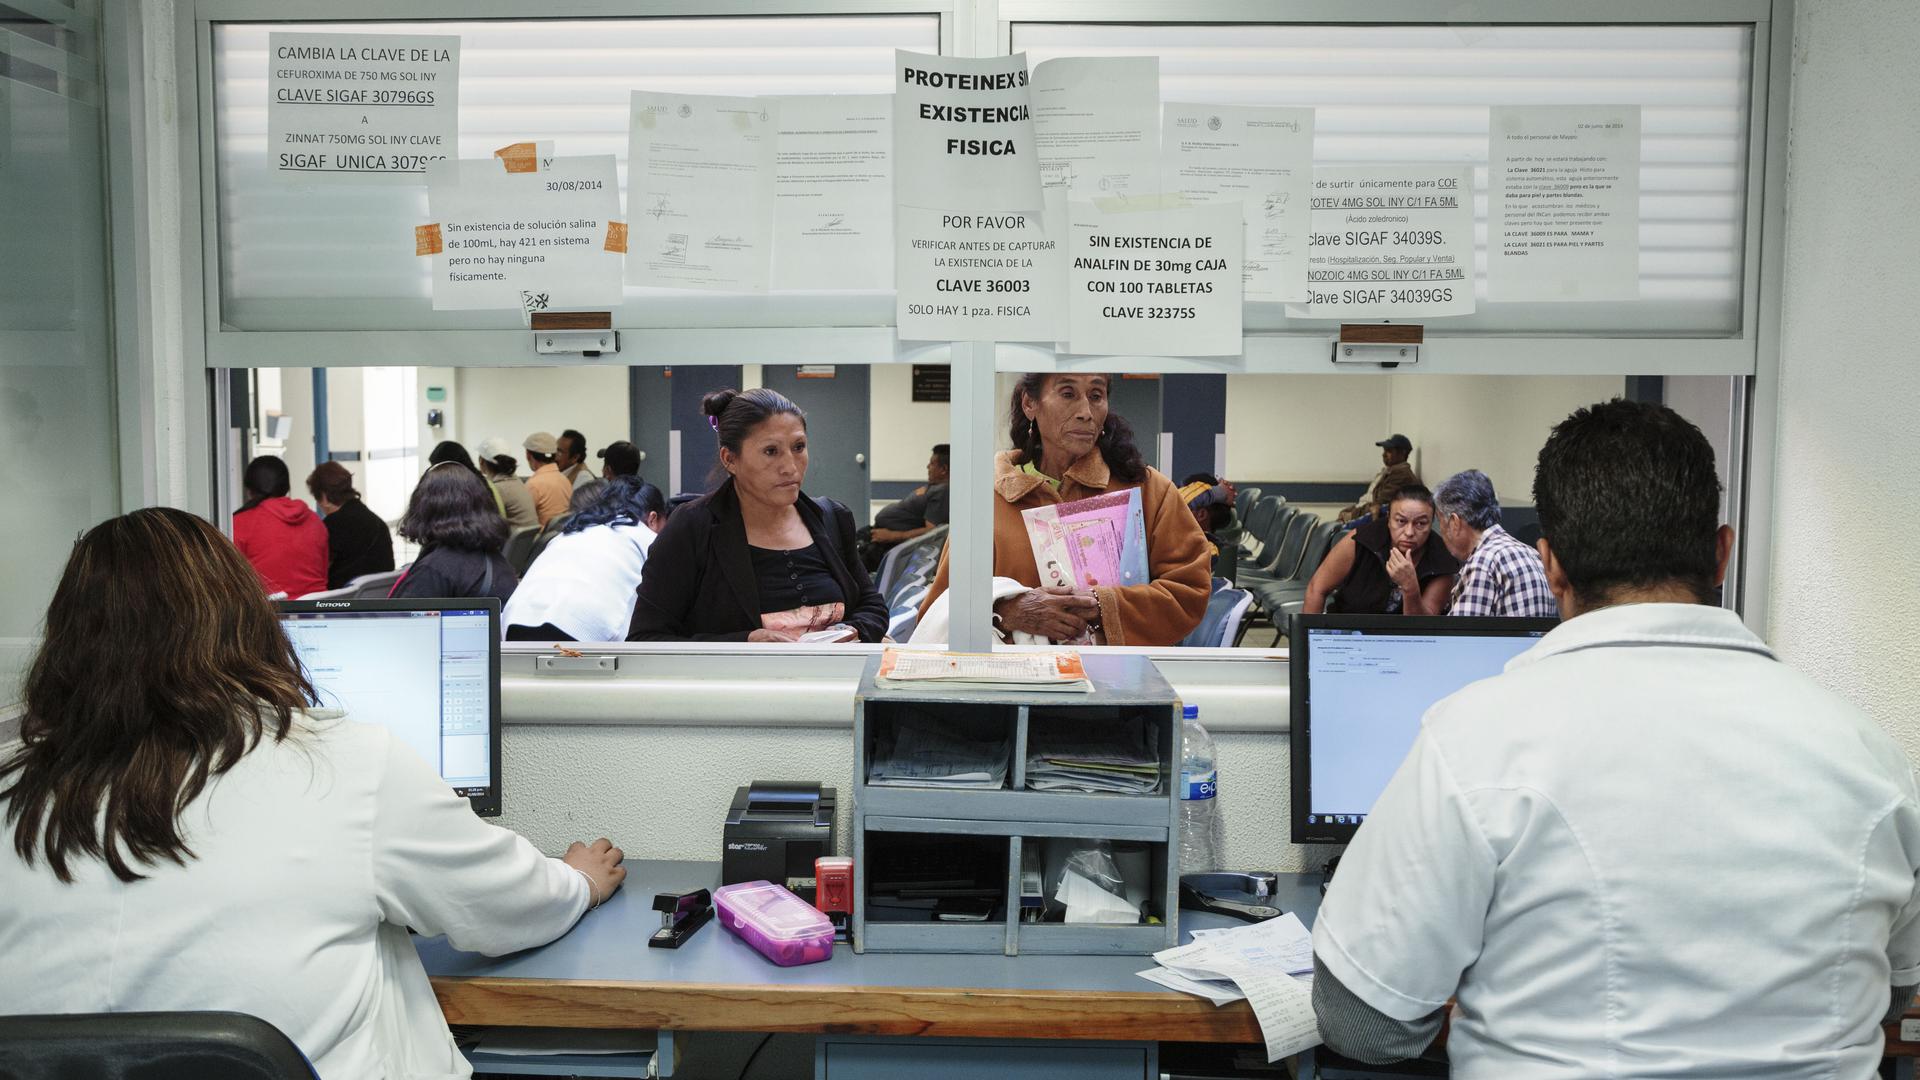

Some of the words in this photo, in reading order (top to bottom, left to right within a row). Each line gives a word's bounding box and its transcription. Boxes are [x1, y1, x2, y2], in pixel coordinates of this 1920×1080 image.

[278, 47, 335, 60] CAMBIA
[340, 48, 356, 60] LA
[362, 48, 406, 61] CLAVE
[411, 49, 429, 62] DE
[434, 50, 450, 62] LA
[277, 70, 342, 80] CEFUROXIMA
[345, 71, 357, 80] DE
[360, 72, 378, 80] 750
[380, 72, 397, 80] MG
[400, 72, 417, 80] SOL
[420, 72, 436, 80] INY
[904, 67, 1016, 90] PROTEINEX
[278, 88, 322, 102] CLAVE
[326, 90, 368, 102] SIGAF
[372, 90, 434, 103] 30796GS
[920, 103, 1030, 122] EXISTENCIA
[361, 116, 368, 124] A
[286, 133, 325, 144] ZINNAT
[328, 134, 366, 144] 750MG
[368, 135, 388, 144] SOL
[390, 136, 407, 144] INY
[410, 136, 442, 144] CLAVE
[947, 138, 1016, 156] FISICA
[280, 154, 327, 168] SIGAF
[336, 154, 386, 169] UNICA
[391, 156, 446, 169] 3079
[546, 180, 602, 192] 30/08/2014
[1316, 180, 1328, 188] de
[1330, 180, 1354, 188] surtir
[1360, 179, 1412, 188] únicamente
[1416, 180, 1436, 190] para
[1438, 178, 1457, 188] COE
[1311, 198, 1340, 208] OTEV
[1342, 198, 1364, 207] 4MG
[1366, 197, 1385, 207] SOL
[1388, 197, 1404, 206] INY
[1407, 197, 1422, 206] C/1
[1425, 197, 1438, 206] FA
[1440, 196, 1458, 206] 5ML
[448, 223, 462, 232] Sin
[466, 222, 510, 232] existencia
[513, 221, 524, 230] de
[528, 220, 566, 230] solución
[570, 219, 596, 228] salina
[943, 216, 972, 228] POR
[977, 216, 1025, 228] FAVOR
[448, 240, 460, 248] de
[464, 239, 496, 249] 100mL,
[500, 238, 516, 248] hay
[519, 237, 536, 246] 421
[540, 238, 550, 246] en
[554, 236, 590, 246] sistema
[912, 239, 956, 250] VERIFICAR
[959, 242, 990, 250] ANTES
[993, 242, 1006, 250] DE
[1008, 240, 1055, 250] CAPTURAR
[1090, 236, 1110, 248] SIN
[1114, 237, 1190, 248] EXISTENCIA
[1195, 237, 1212, 248] DE
[1346, 232, 1388, 246] SIGAF
[1393, 230, 1446, 245] 34039S.
[448, 257, 471, 266] pero
[488, 255, 504, 265] hay
[508, 254, 545, 264] ninguna
[934, 258, 946, 266] LA
[948, 258, 1003, 268] EXISTENCIA
[1006, 259, 1018, 268] DE
[1022, 259, 1032, 267] LA
[1074, 258, 1129, 271] ANALFIN
[1134, 260, 1151, 270] DE
[1155, 260, 1192, 274] 30mg
[1196, 259, 1227, 270] CAJA
[1348, 270, 1368, 280] 4MG
[1372, 270, 1390, 280] SOL
[1394, 270, 1409, 280] INY
[1412, 270, 1426, 280] C/1
[1430, 270, 1442, 278] FA
[1446, 268, 1464, 278] 5ML
[936, 279, 982, 292] CLAVE
[986, 280, 1030, 292] 36003
[1088, 281, 1115, 292] CON
[1120, 282, 1143, 293] 100
[1147, 282, 1212, 294] TABLETAS
[1344, 290, 1386, 304] SIGAF
[1390, 288, 1452, 304] 34039GS
[908, 304, 934, 315] SOLO
[936, 306, 958, 316] HAY
[962, 306, 968, 316] 1
[972, 307, 993, 318] pza.
[998, 306, 1030, 316] FISICA
[1102, 306, 1144, 318] CLAVE
[1148, 308, 1196, 318] 32375S
